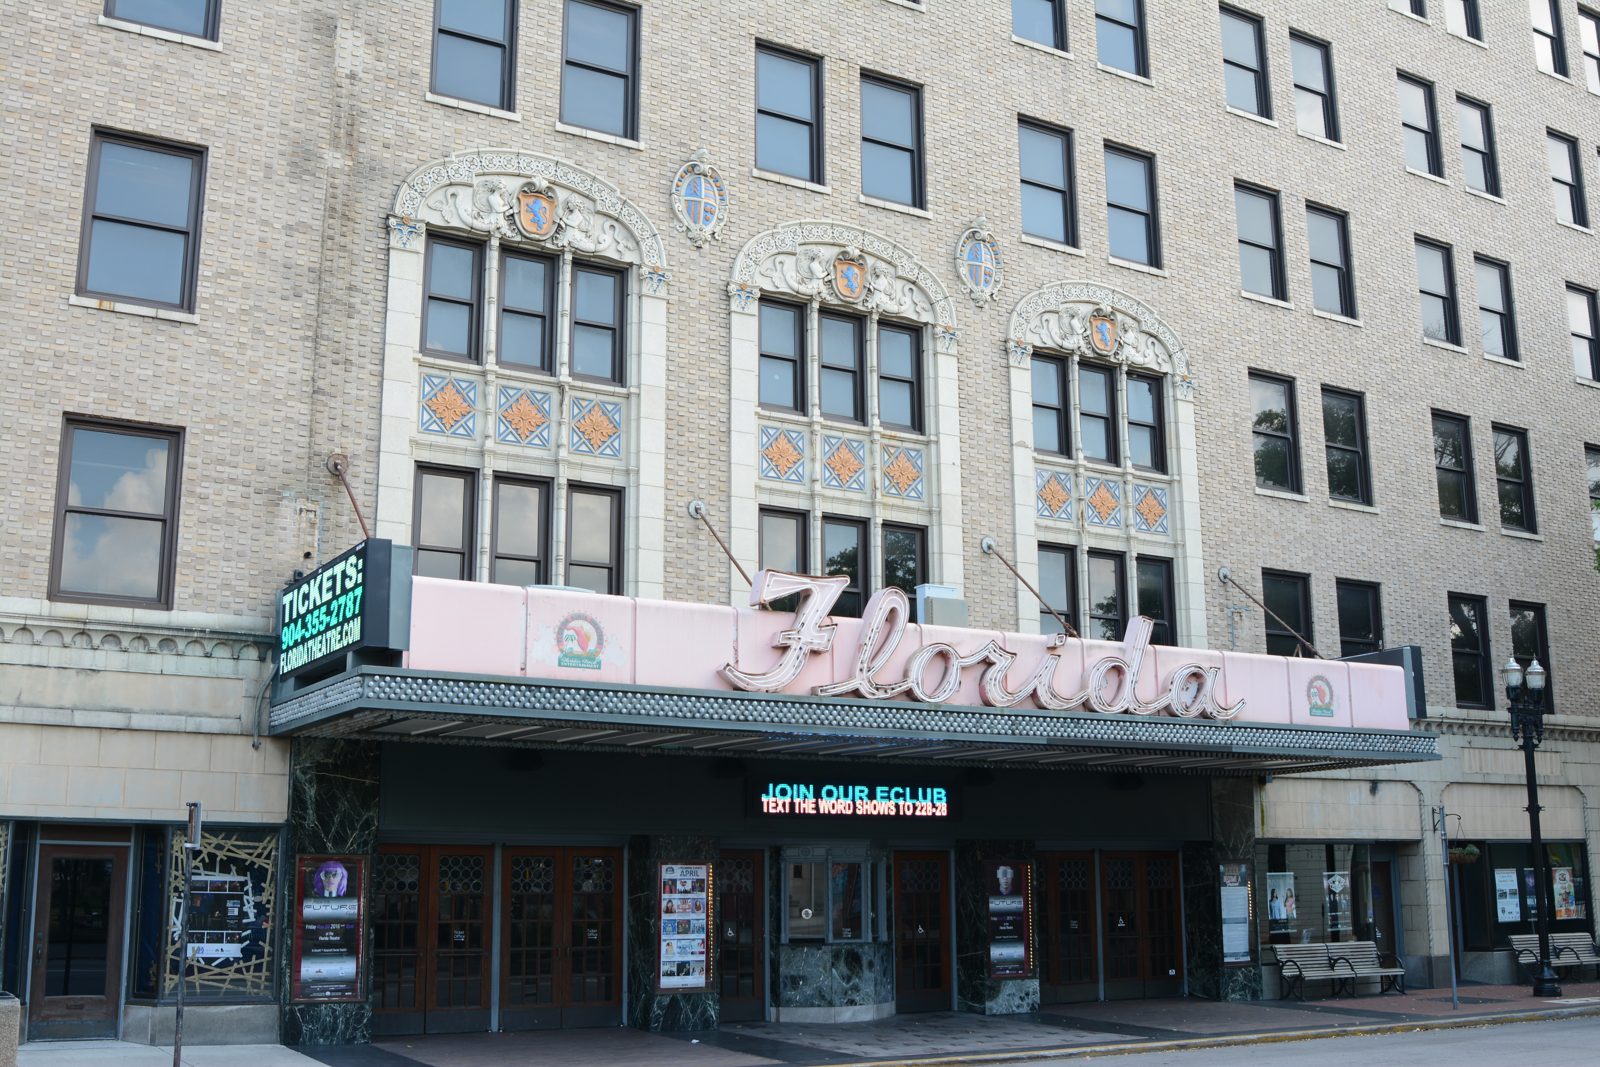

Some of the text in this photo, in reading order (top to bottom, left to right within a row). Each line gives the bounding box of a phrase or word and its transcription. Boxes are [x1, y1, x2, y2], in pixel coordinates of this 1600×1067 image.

[281, 586, 363, 650] 904-355-2787
[283, 555, 363, 623] TICKETS:
[280, 616, 361, 675] FLORIDATHEATRE.COM
[716, 568, 1247, 720] Florida
[761, 783, 947, 804] JOIN OUR ECLUB
[761, 798, 947, 816] TEXT THE WORD SHOWS TO 228-28
